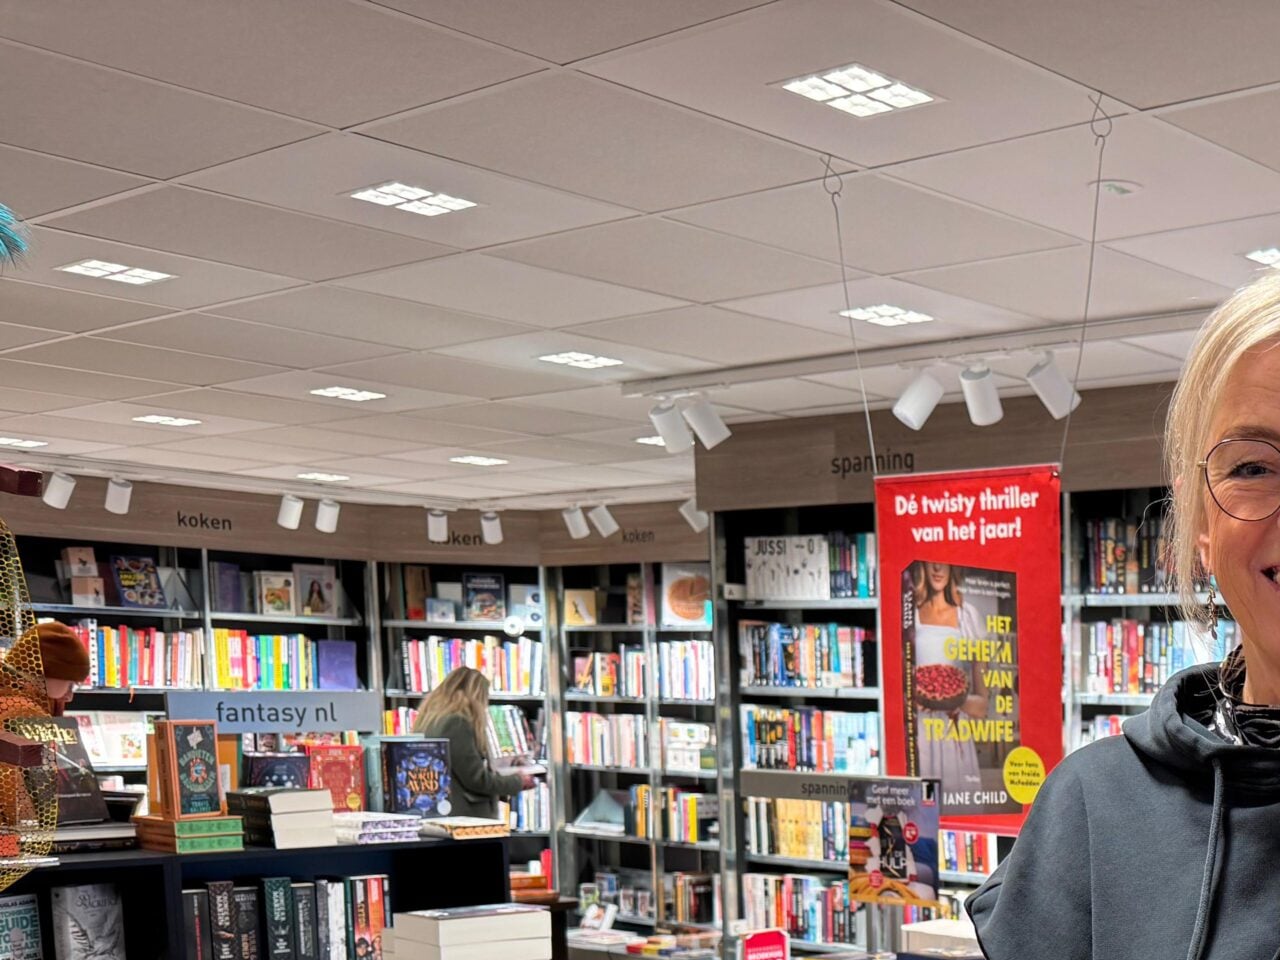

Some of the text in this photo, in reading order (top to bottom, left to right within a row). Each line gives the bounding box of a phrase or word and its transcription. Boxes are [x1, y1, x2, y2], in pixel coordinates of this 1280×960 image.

[831, 448, 915, 474] spanning
[894, 485, 1039, 518] Dé twisty thriller
[177, 510, 232, 531] koken
[430, 531, 483, 546] oken
[622, 529, 655, 543] koken
[912, 516, 1022, 546] van het jaar!
[755, 539, 787, 556] JUSSI
[986, 614, 1012, 634] HET
[943, 636, 1012, 664] GEHEIM
[981, 669, 1013, 689] VAN
[216, 701, 338, 727] fantasy nl
[995, 695, 1014, 714] DE
[923, 717, 1014, 742] TRADWIFE
[801, 781, 852, 798] spannin
[943, 791, 1008, 805] IANE CHILD
